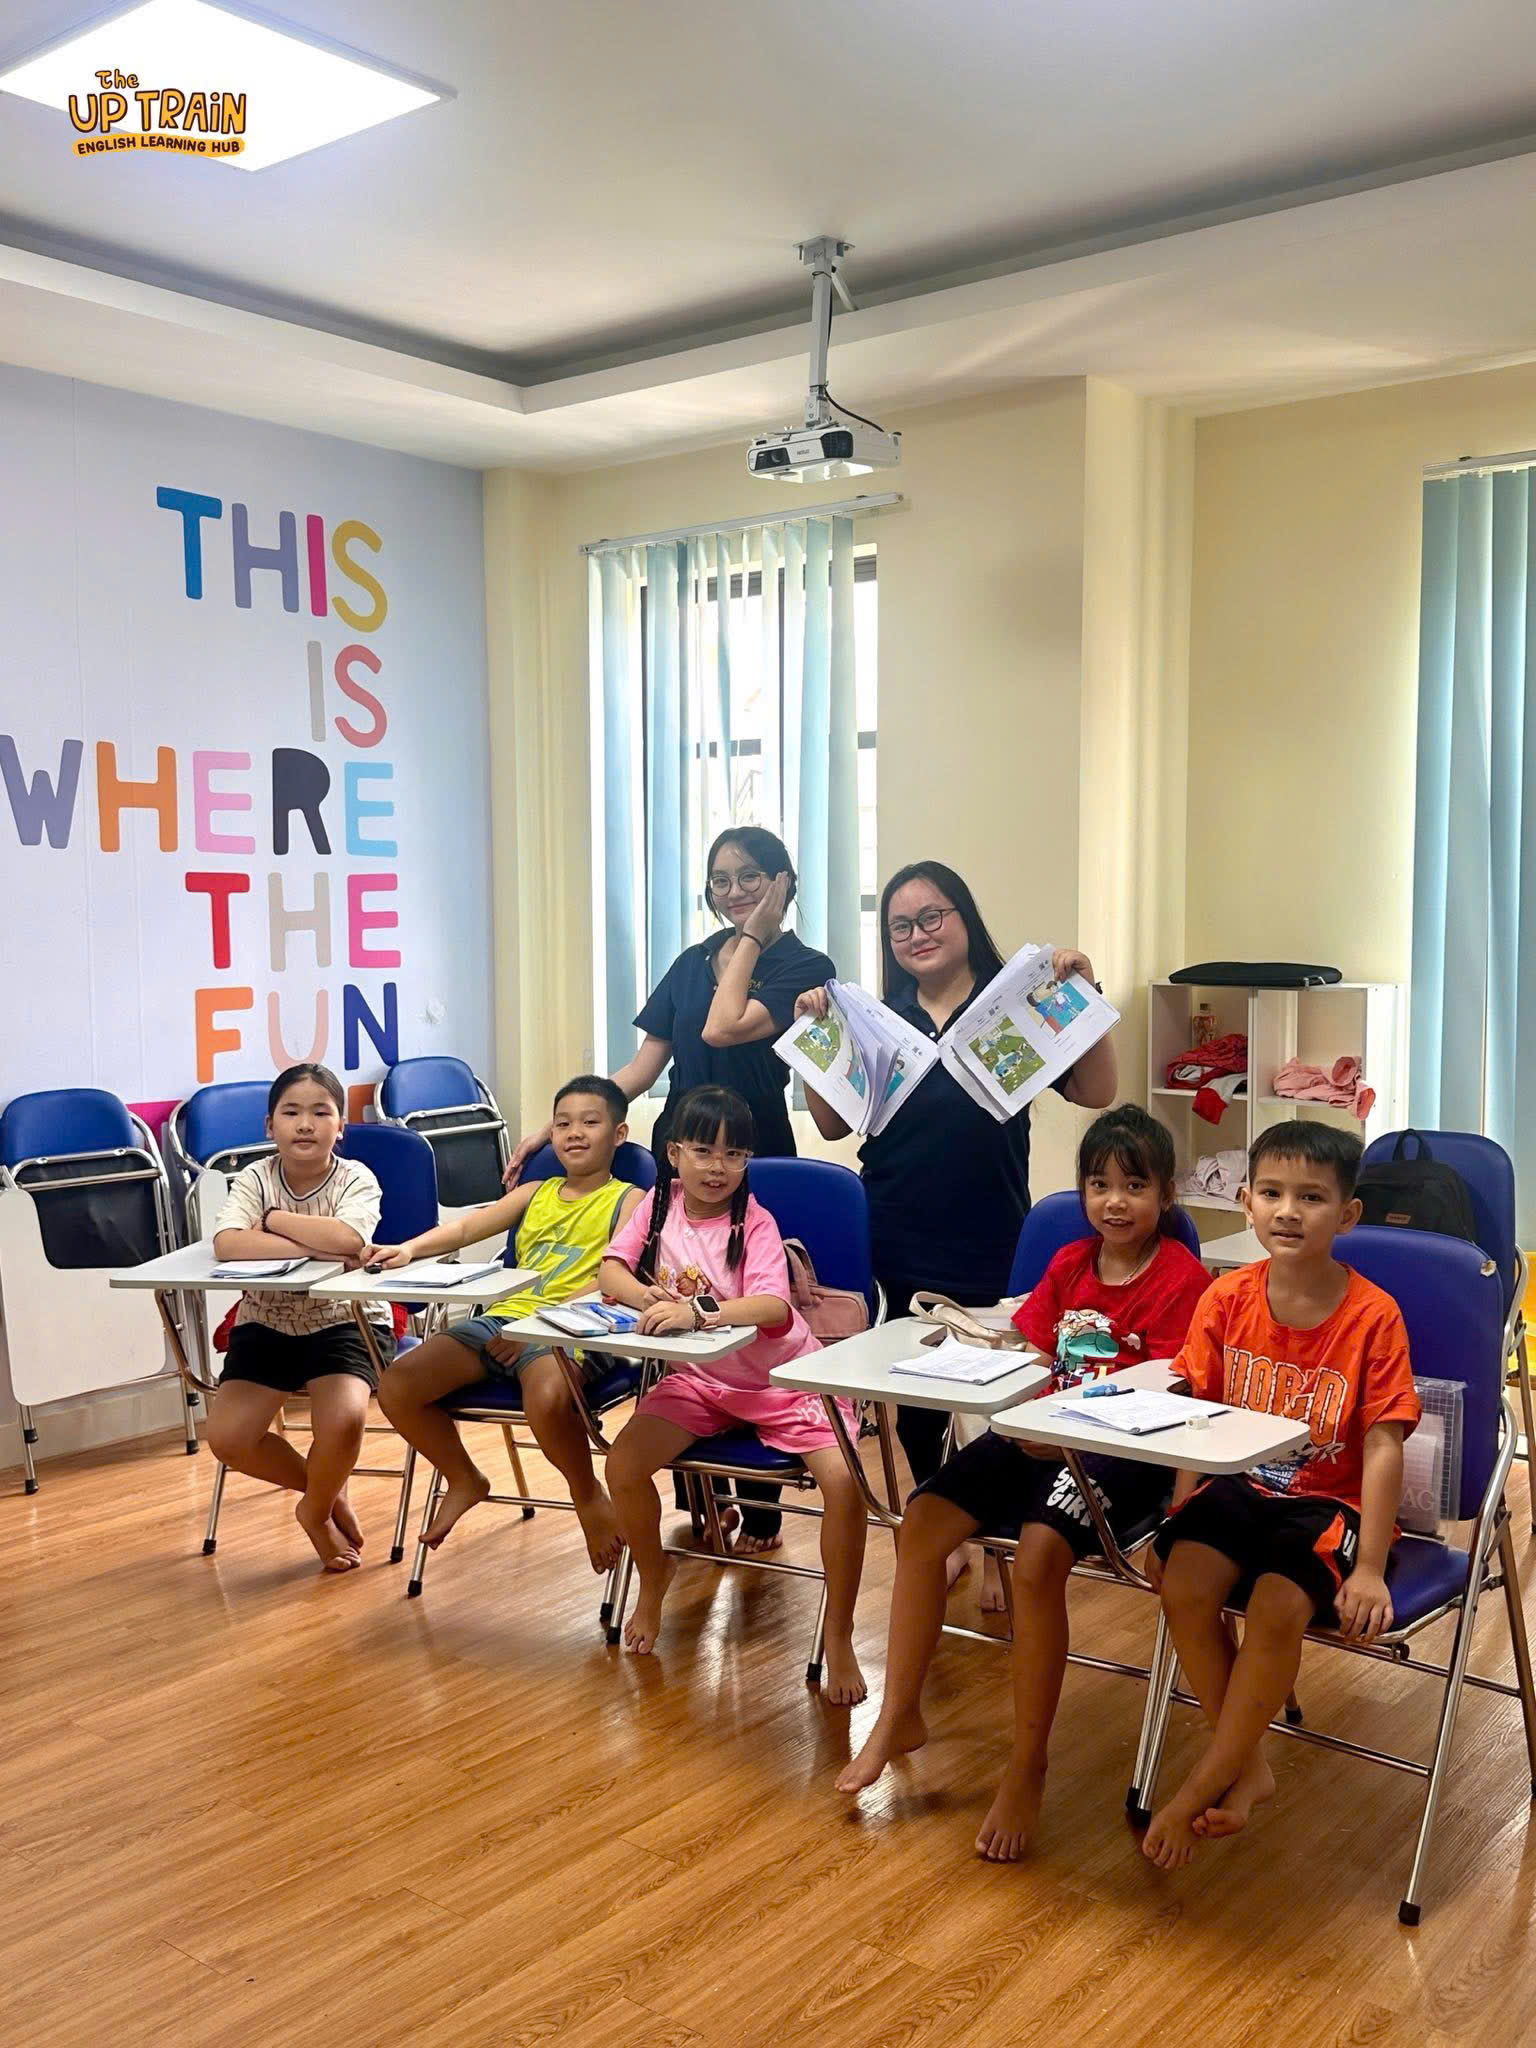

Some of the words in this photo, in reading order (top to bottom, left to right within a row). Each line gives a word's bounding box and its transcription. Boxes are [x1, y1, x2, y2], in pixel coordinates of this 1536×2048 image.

[156, 485, 389, 633] THIS
[306, 640, 388, 748] IS
[0, 733, 398, 858] WHERE
[185, 871, 402, 972] THE
[195, 982, 400, 1083] FUN
